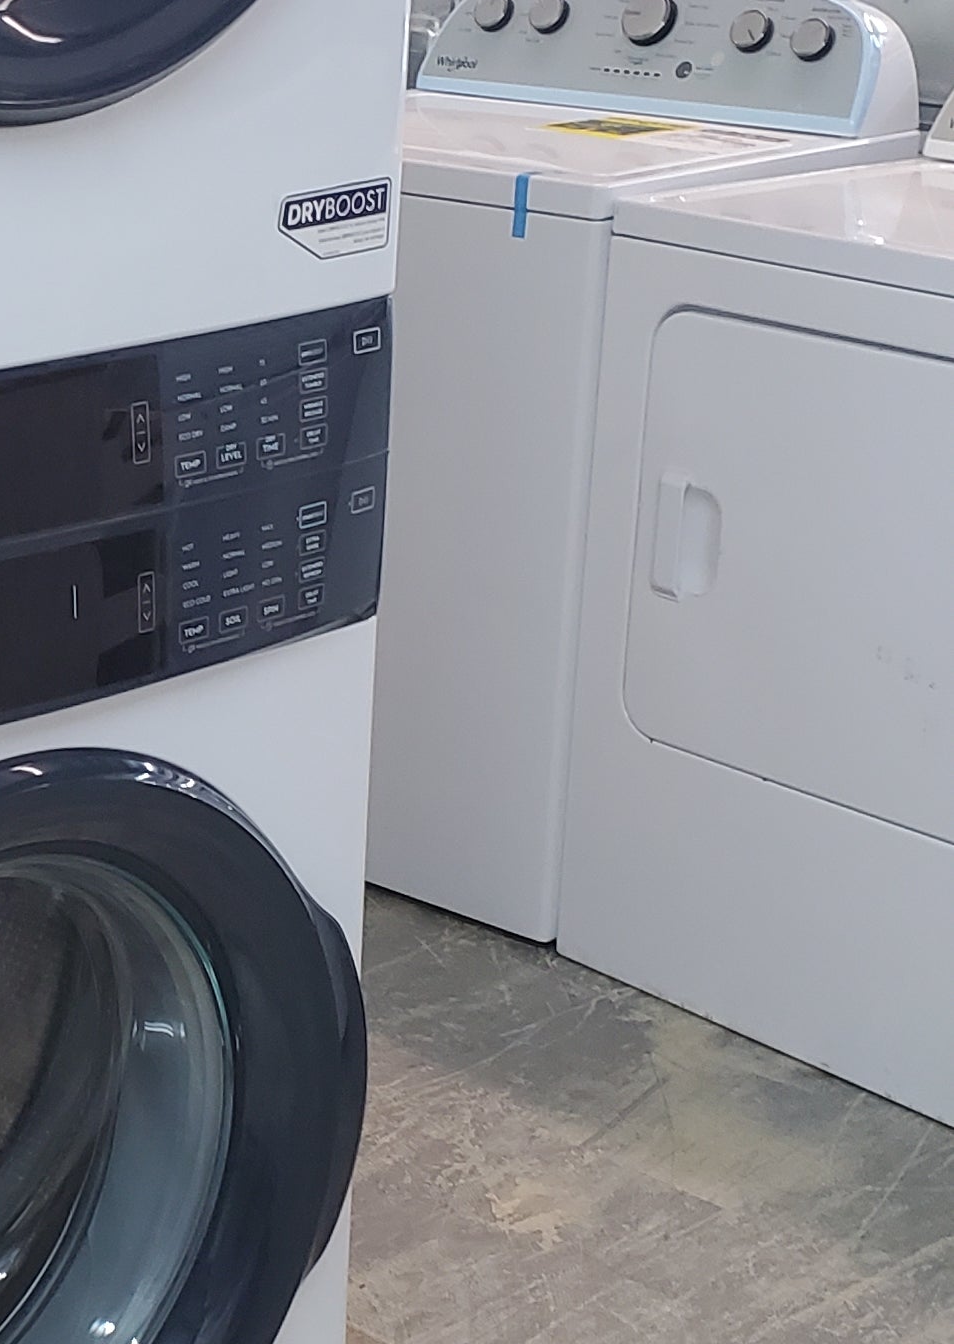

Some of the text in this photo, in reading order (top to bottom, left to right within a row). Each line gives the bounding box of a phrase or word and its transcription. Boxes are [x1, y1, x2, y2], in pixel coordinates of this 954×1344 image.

[437, 56, 478, 72] Whirlpool
[287, 188, 385, 226] DRYBOOST
[220, 450, 243, 463] LEVEL
[180, 458, 201, 471] TEMP
[225, 615, 241, 626] SOIL
[184, 624, 204, 637] TEMP
